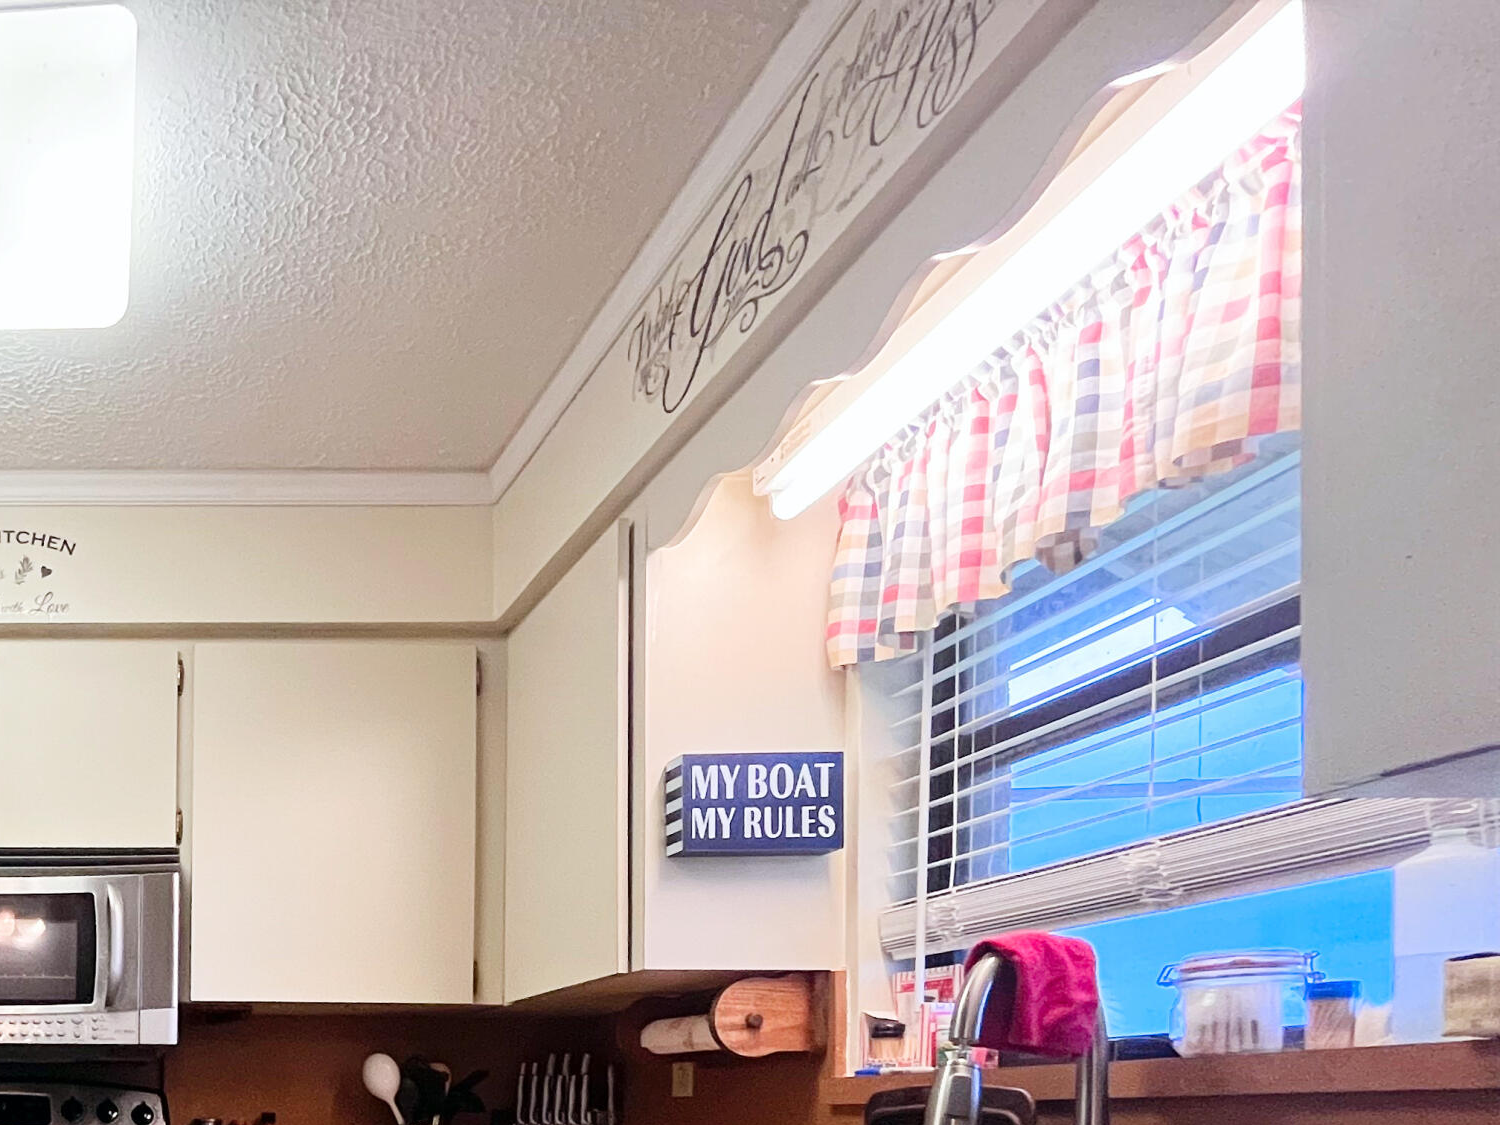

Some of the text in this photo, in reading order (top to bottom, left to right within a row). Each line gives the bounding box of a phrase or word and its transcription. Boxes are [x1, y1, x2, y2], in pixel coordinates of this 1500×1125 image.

[28, 591, 70, 615] Love
[691, 763, 836, 800] MY BOAT
[691, 804, 837, 840] MY RULES
